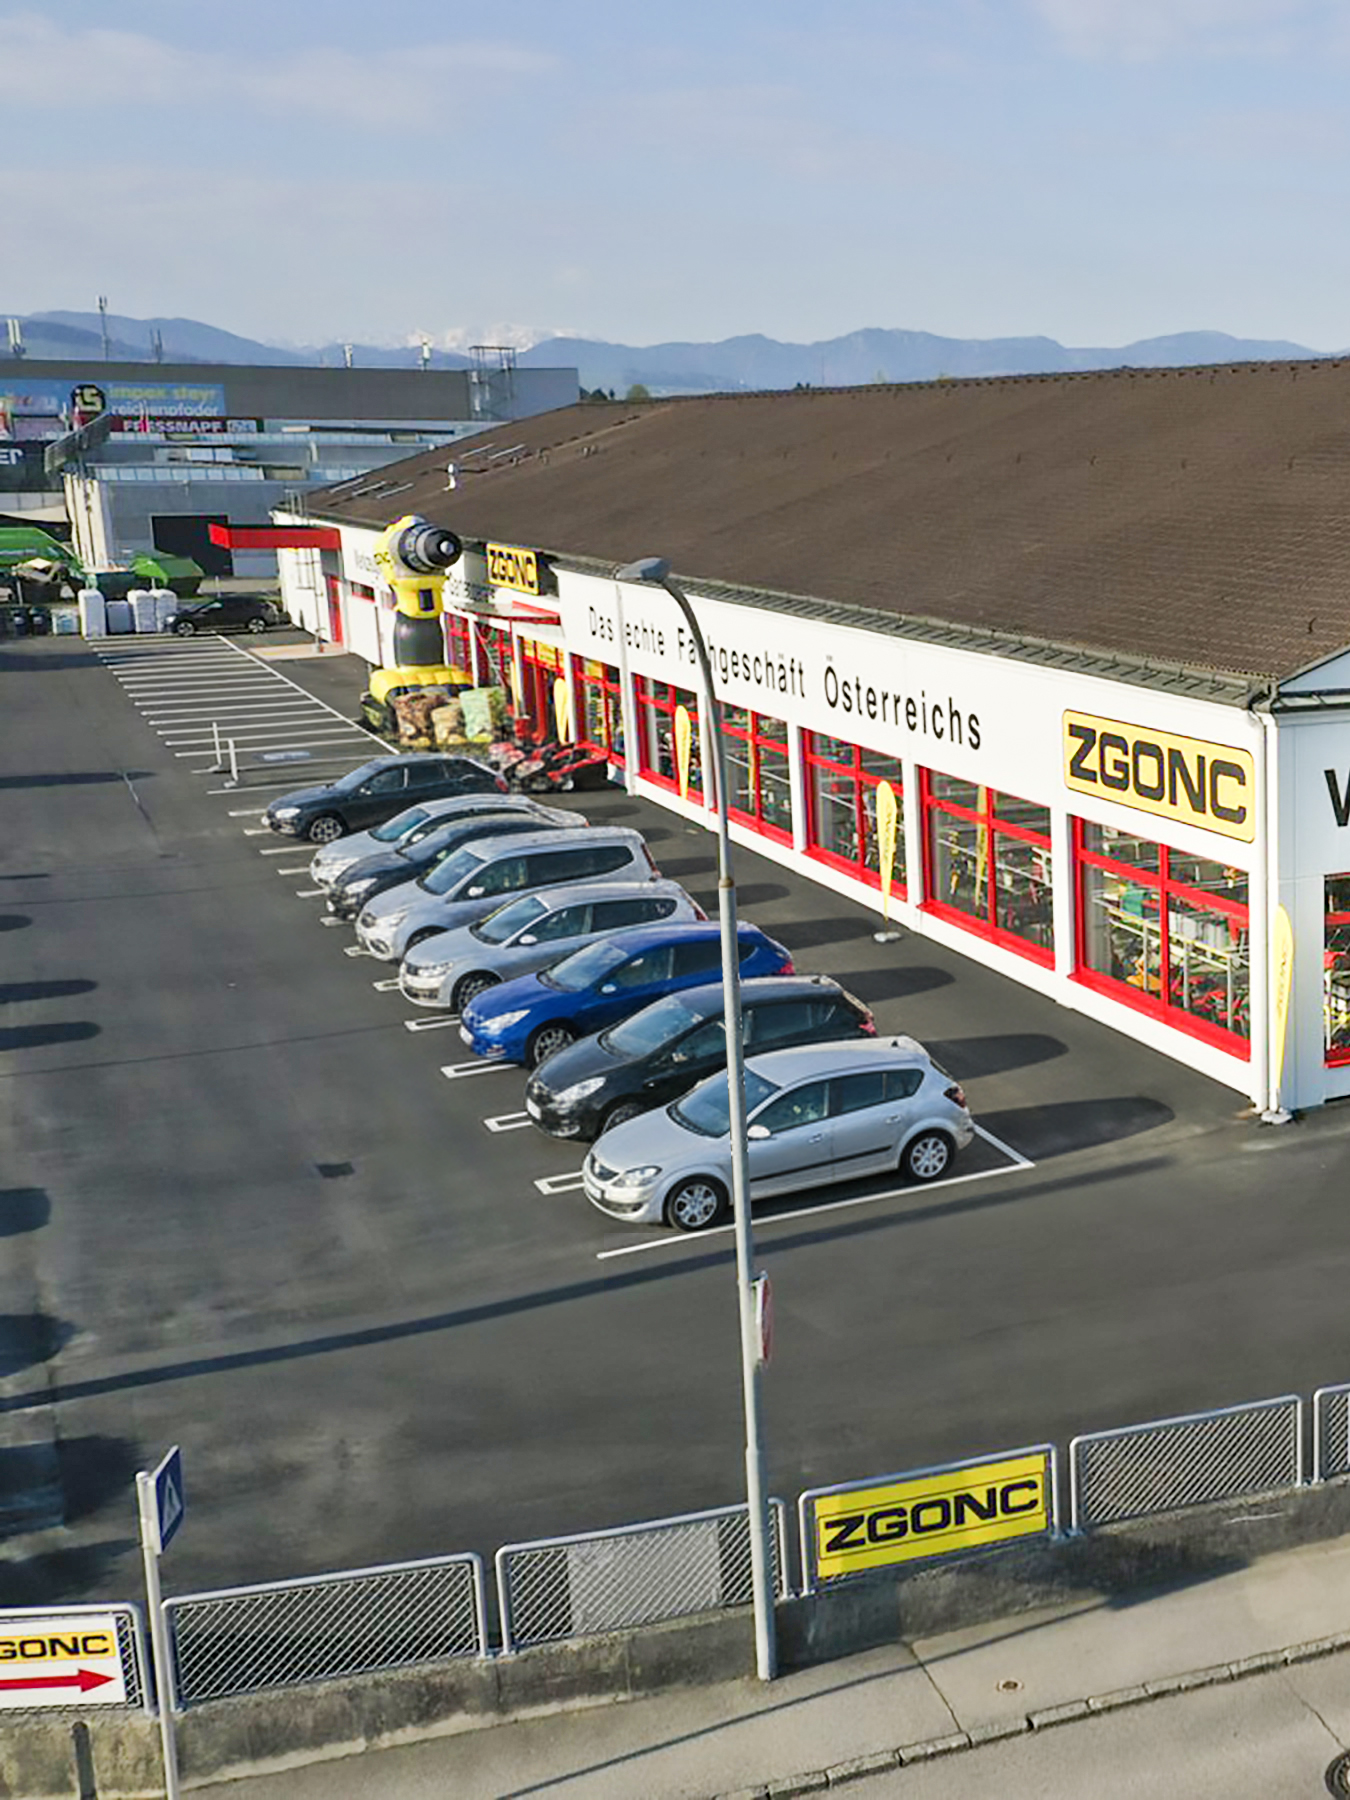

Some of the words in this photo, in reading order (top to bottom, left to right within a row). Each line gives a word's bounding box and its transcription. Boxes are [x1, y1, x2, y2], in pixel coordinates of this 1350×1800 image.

[490, 549, 535, 588] ZGONC
[589, 606, 614, 641] Das
[626, 614, 665, 657] echte
[677, 627, 805, 698] Fahgeschäft
[824, 655, 981, 750] Österreichs
[1069, 723, 1246, 824] ZGONC
[825, 1480, 1039, 1552] ZGONC
